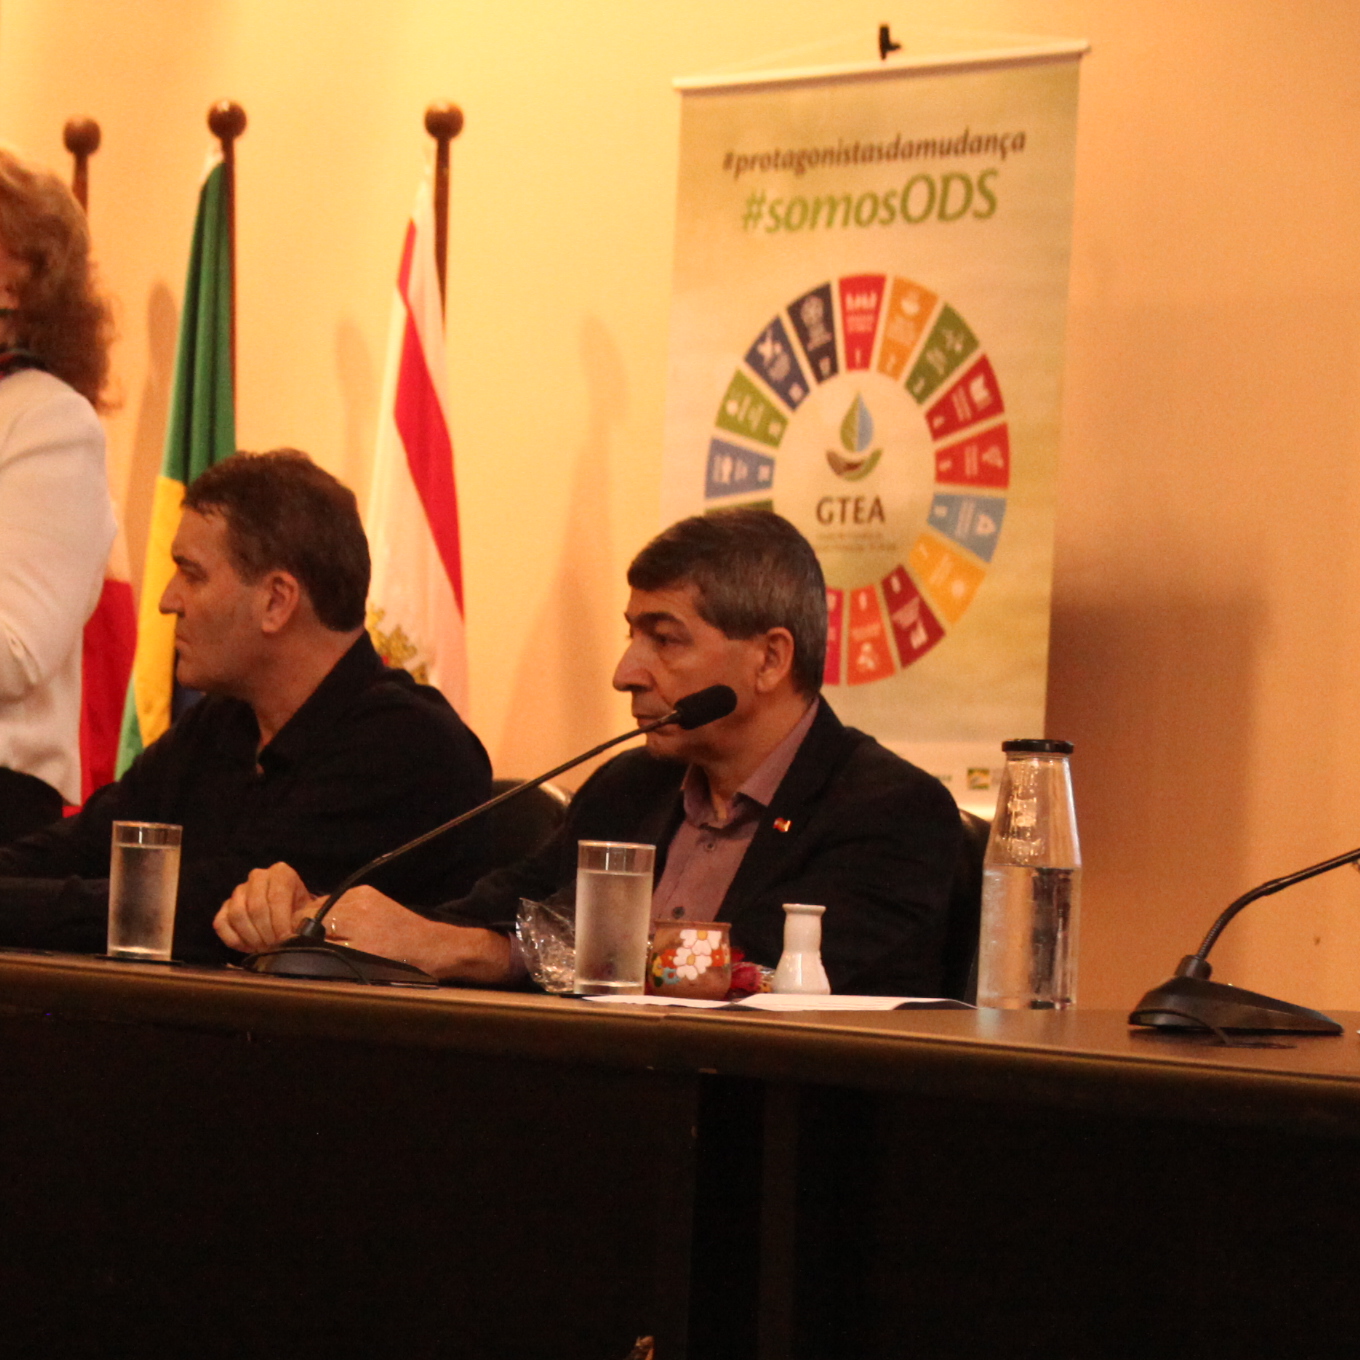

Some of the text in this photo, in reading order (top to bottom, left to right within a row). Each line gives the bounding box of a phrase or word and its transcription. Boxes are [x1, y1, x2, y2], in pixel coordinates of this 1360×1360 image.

[722, 126, 1026, 180] #protagonistasdamudança
[742, 168, 1000, 234] #somosODS
[815, 494, 886, 525] GTEA
